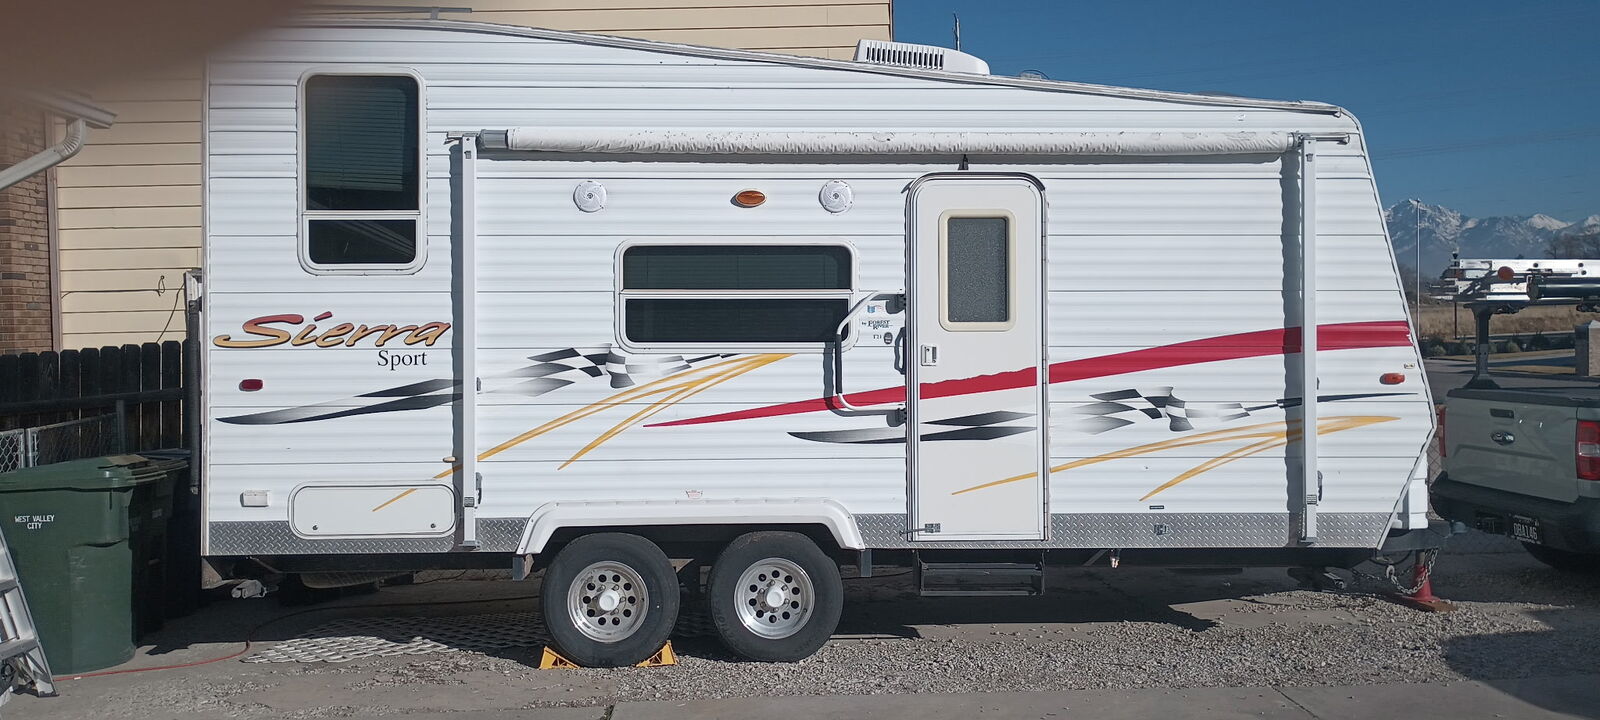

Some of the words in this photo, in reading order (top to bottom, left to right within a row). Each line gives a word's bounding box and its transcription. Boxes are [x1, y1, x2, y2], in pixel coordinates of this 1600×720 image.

[212, 311, 451, 348] Sierra
[377, 350, 427, 371] Sport
[14, 515, 31, 523] WEST
[32, 514, 55, 523] VALLEY
[27, 522, 42, 530] CITY
